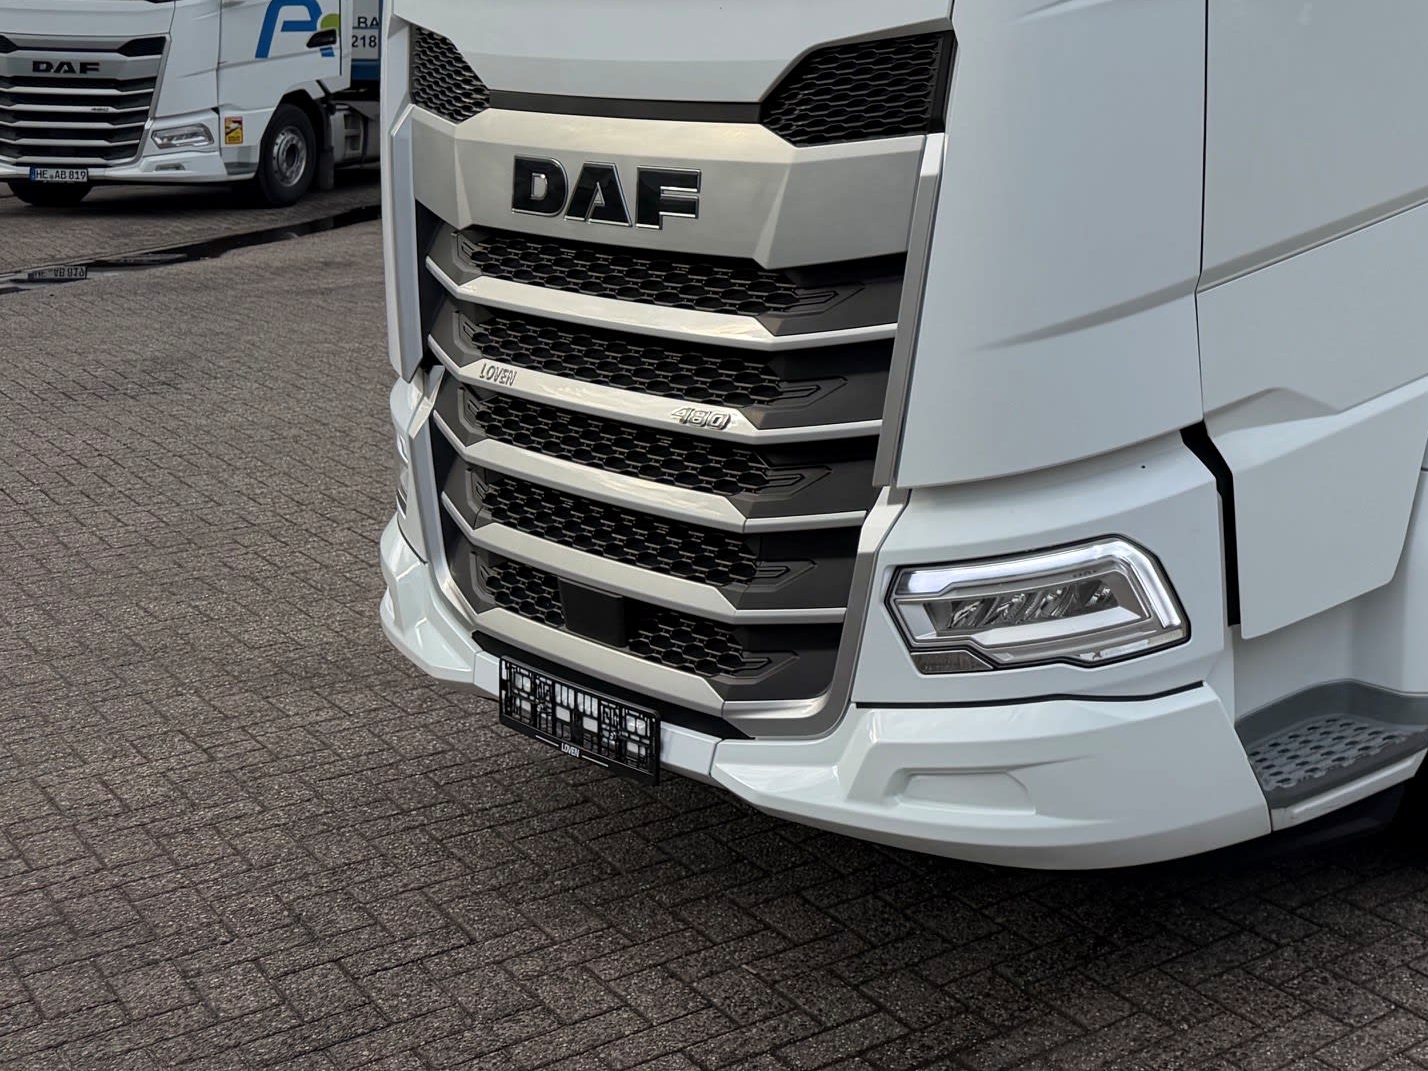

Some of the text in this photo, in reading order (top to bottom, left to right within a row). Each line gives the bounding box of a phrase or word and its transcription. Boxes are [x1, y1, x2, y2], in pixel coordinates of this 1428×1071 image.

[32, 60, 100, 75] DAF
[512, 155, 701, 230] DAF
[479, 362, 518, 388] LOVEN
[670, 407, 731, 430] 480
[561, 742, 580, 758] LOVEN
